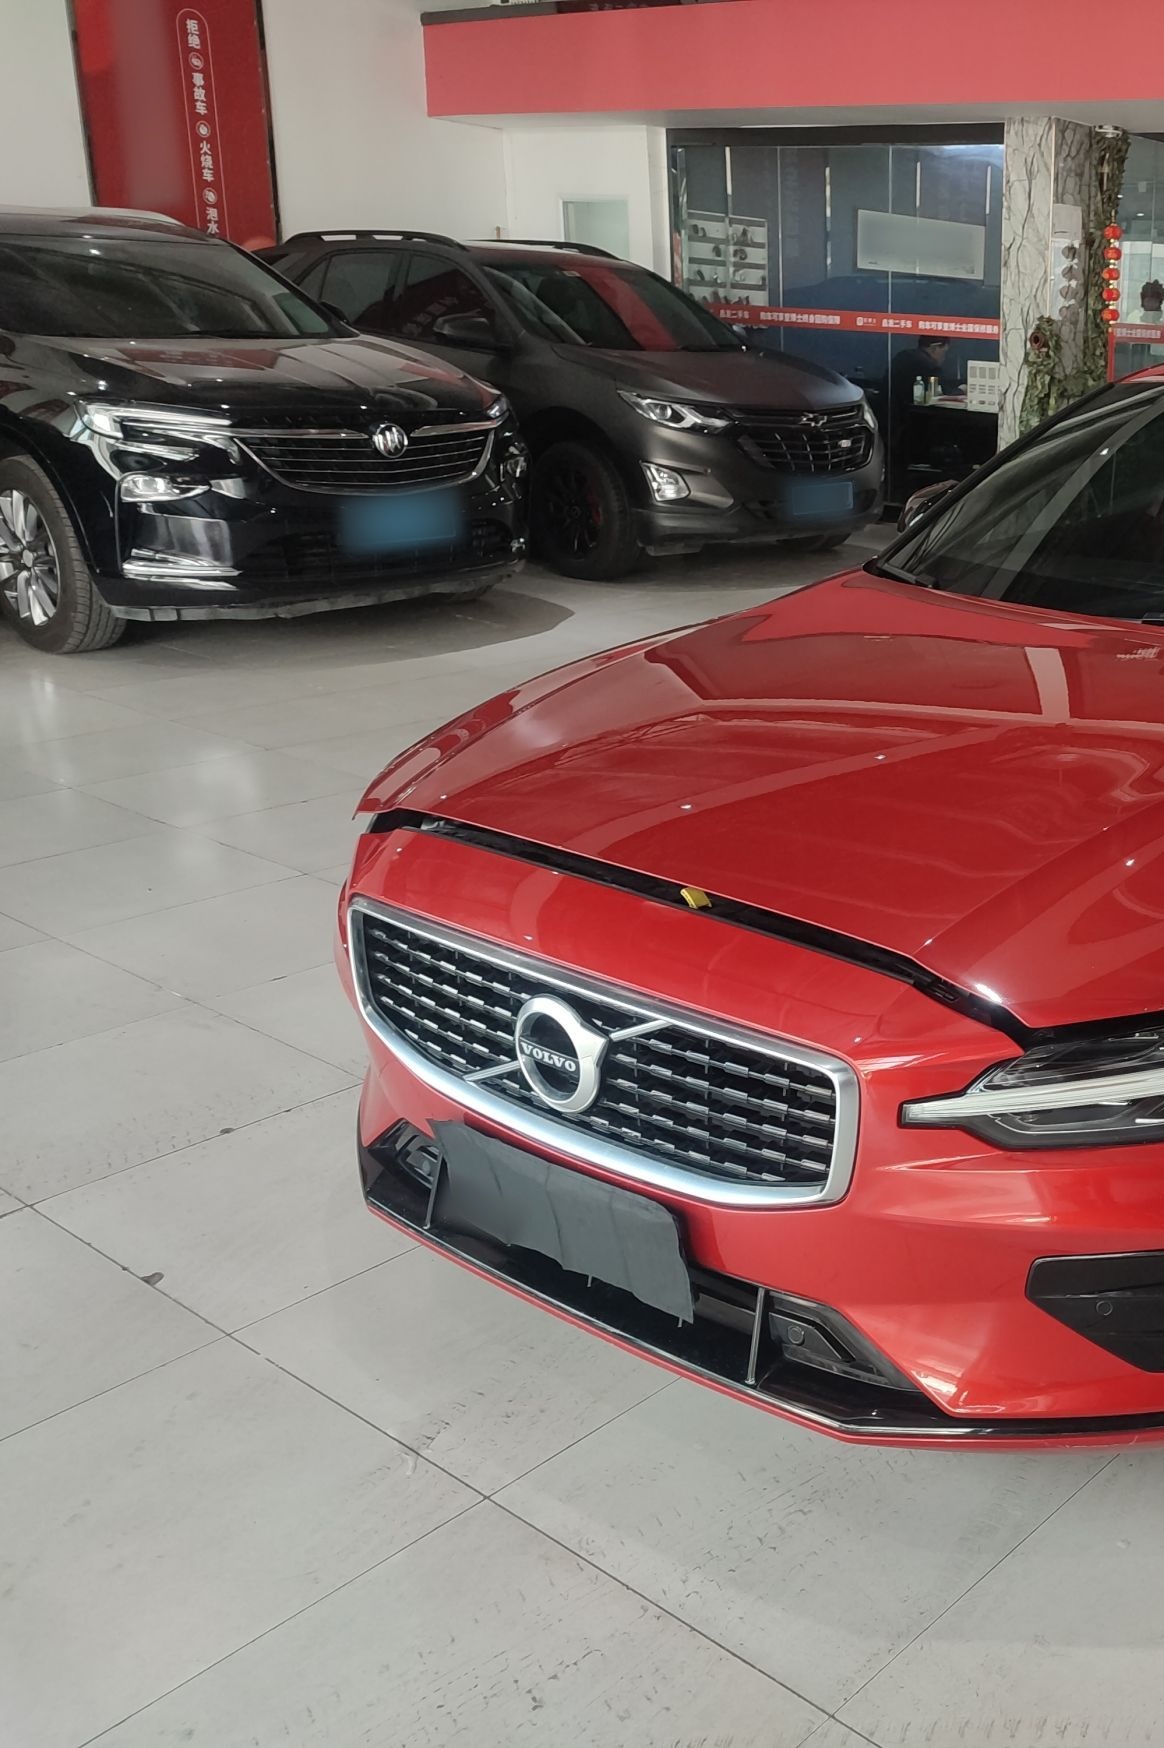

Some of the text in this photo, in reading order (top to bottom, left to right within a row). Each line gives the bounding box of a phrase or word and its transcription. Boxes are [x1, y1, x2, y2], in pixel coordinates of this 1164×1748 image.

[186, 18, 201, 49] 拒绝
[192, 72, 208, 115] 事故车
[200, 140, 215, 182] 火烧车
[520, 1041, 577, 1072] VOLVO
